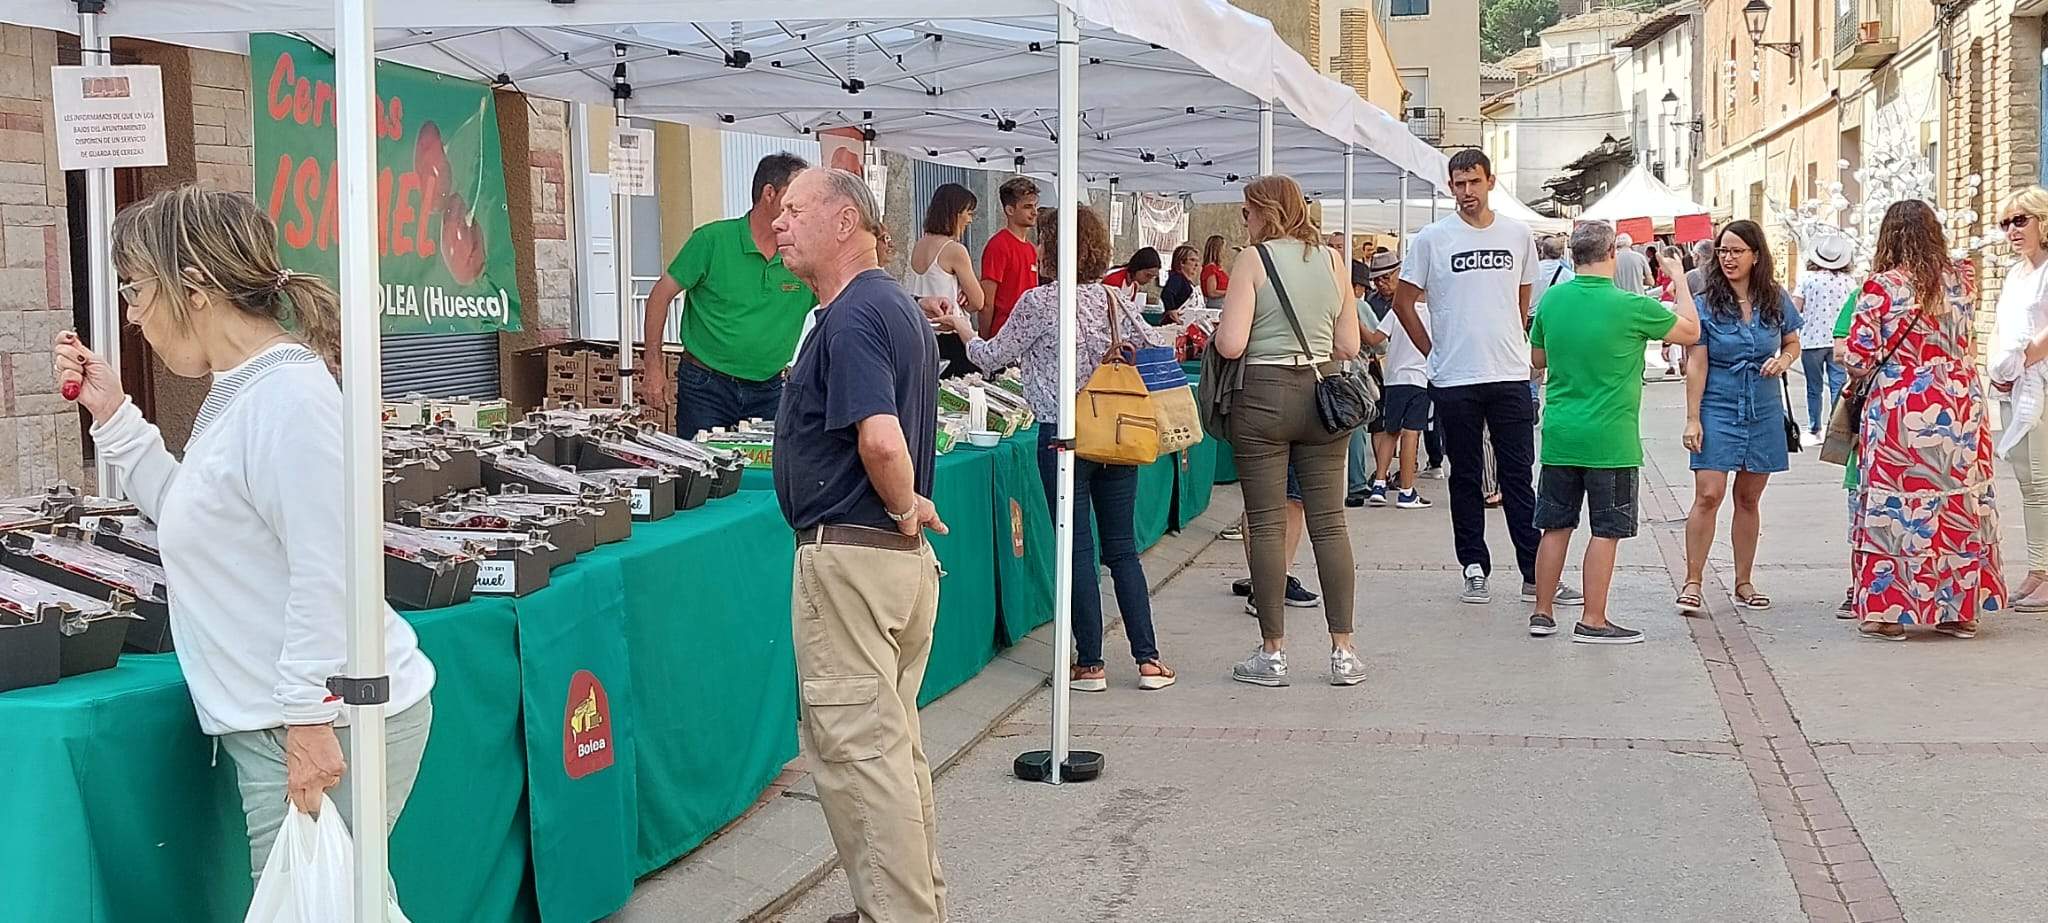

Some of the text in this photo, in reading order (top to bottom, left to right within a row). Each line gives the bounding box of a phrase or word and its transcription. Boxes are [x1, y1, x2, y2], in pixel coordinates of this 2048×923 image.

[73, 113, 112, 121] INFORMAMOS
[121, 112, 133, 120] QUE
[102, 124, 146, 132] AYUNTAMIENTO
[75, 137, 102, 145] DISPONEN
[121, 135, 146, 143] SERVICIO
[89, 150, 112, 158] GUARDA
[112, 149, 120, 157] DE
[120, 148, 145, 156] CEREZAS
[1453, 251, 1513, 269] adidas
[424, 286, 509, 325] (Huesca)
[577, 738, 606, 758] Bolea
